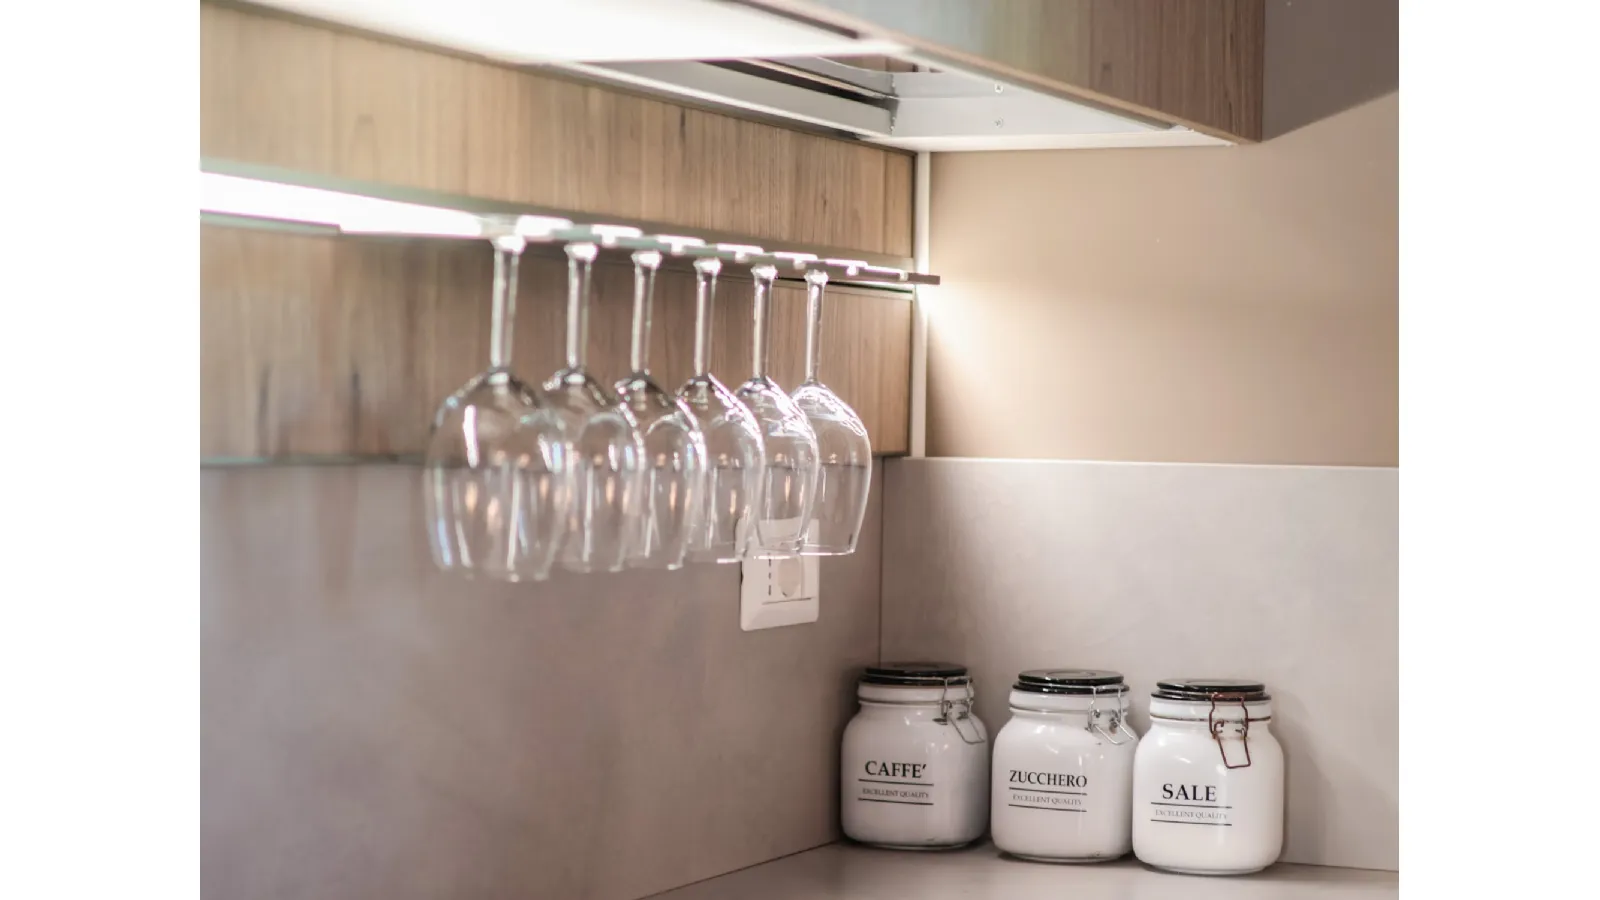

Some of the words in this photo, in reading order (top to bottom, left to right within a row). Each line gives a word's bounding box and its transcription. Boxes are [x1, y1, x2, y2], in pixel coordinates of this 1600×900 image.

[1009, 769, 1088, 788] ZUCCHERO
[862, 787, 899, 797] EXCELLENT
[900, 791, 930, 799] QUALITY
[1012, 793, 1050, 804] EXCELLENT
[1051, 797, 1083, 806] QUALITY
[1162, 783, 1218, 802] SALE
